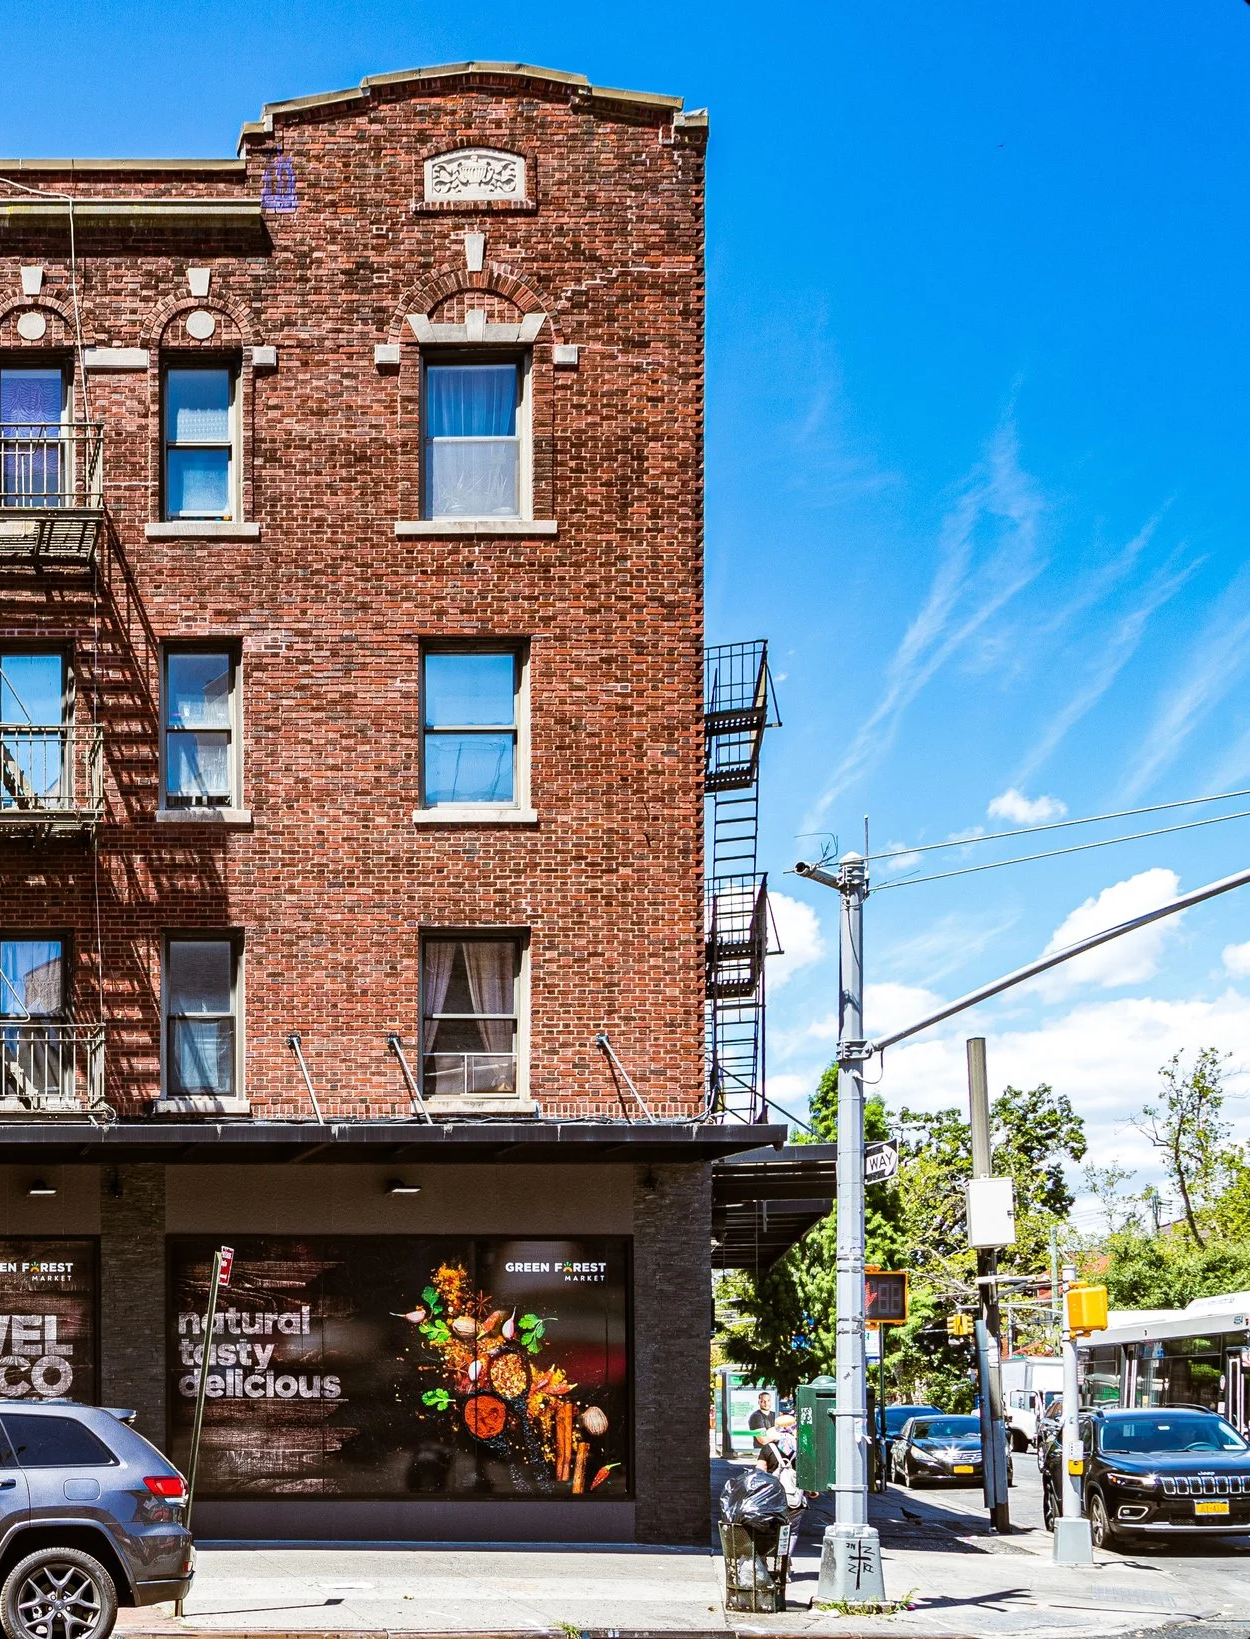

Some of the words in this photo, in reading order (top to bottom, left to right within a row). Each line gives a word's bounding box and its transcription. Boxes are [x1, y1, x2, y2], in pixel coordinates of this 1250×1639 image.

[869, 1151, 893, 1169] WAY
[505, 1262, 550, 1273] GREEN
[178, 1305, 311, 1335] natural
[178, 1339, 275, 1370] tasty
[178, 1369, 342, 1398] delicious
